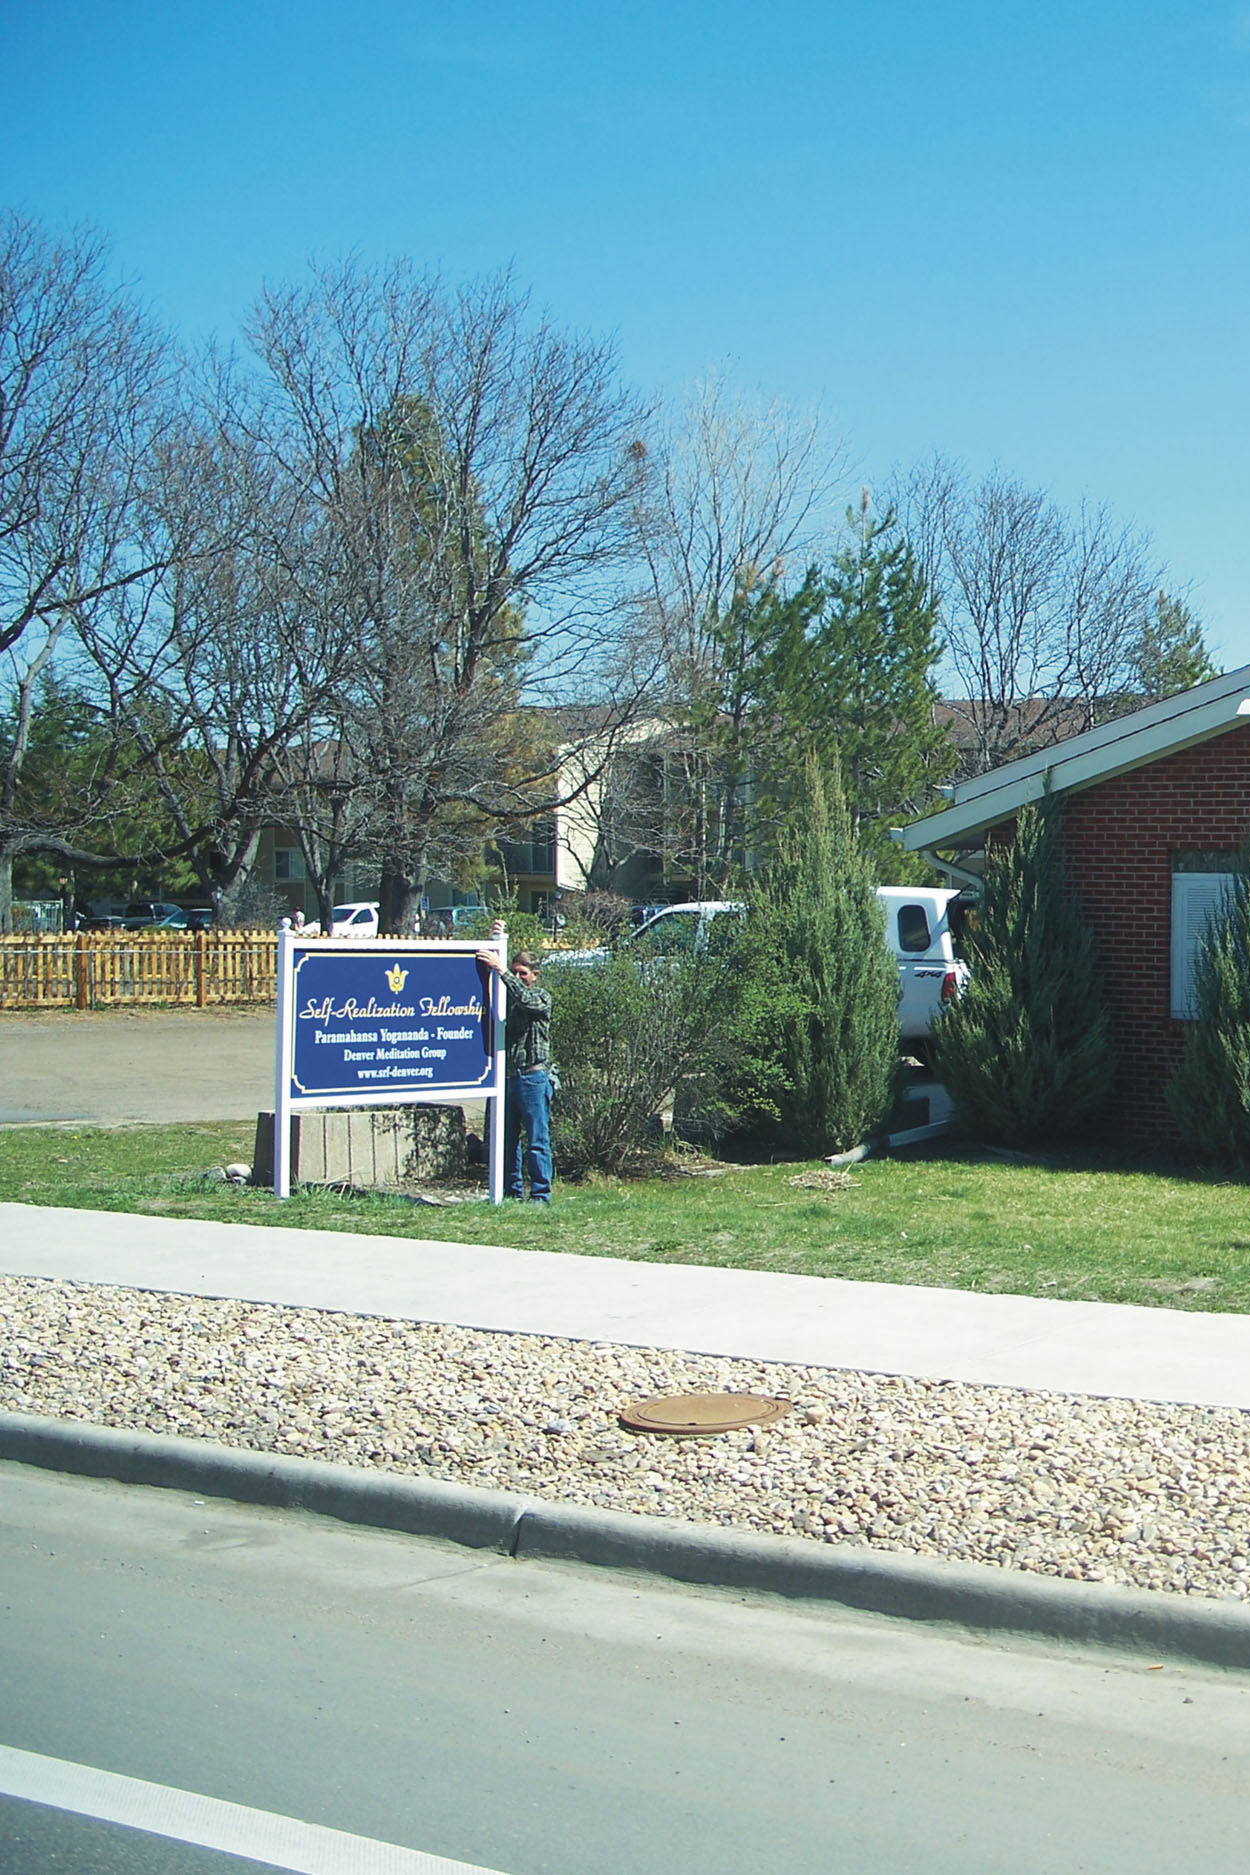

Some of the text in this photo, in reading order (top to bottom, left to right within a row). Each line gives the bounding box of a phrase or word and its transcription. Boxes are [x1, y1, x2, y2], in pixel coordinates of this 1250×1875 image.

[299, 995, 487, 1027] Self-Realization Fellowship
[314, 1029, 379, 1044] Paramahansa
[380, 1027, 429, 1045] Yogananda
[436, 1026, 474, 1041] Founder
[343, 1046, 447, 1062] Denver Meditation Group
[357, 1065, 434, 1079] www.srf-denver.org
